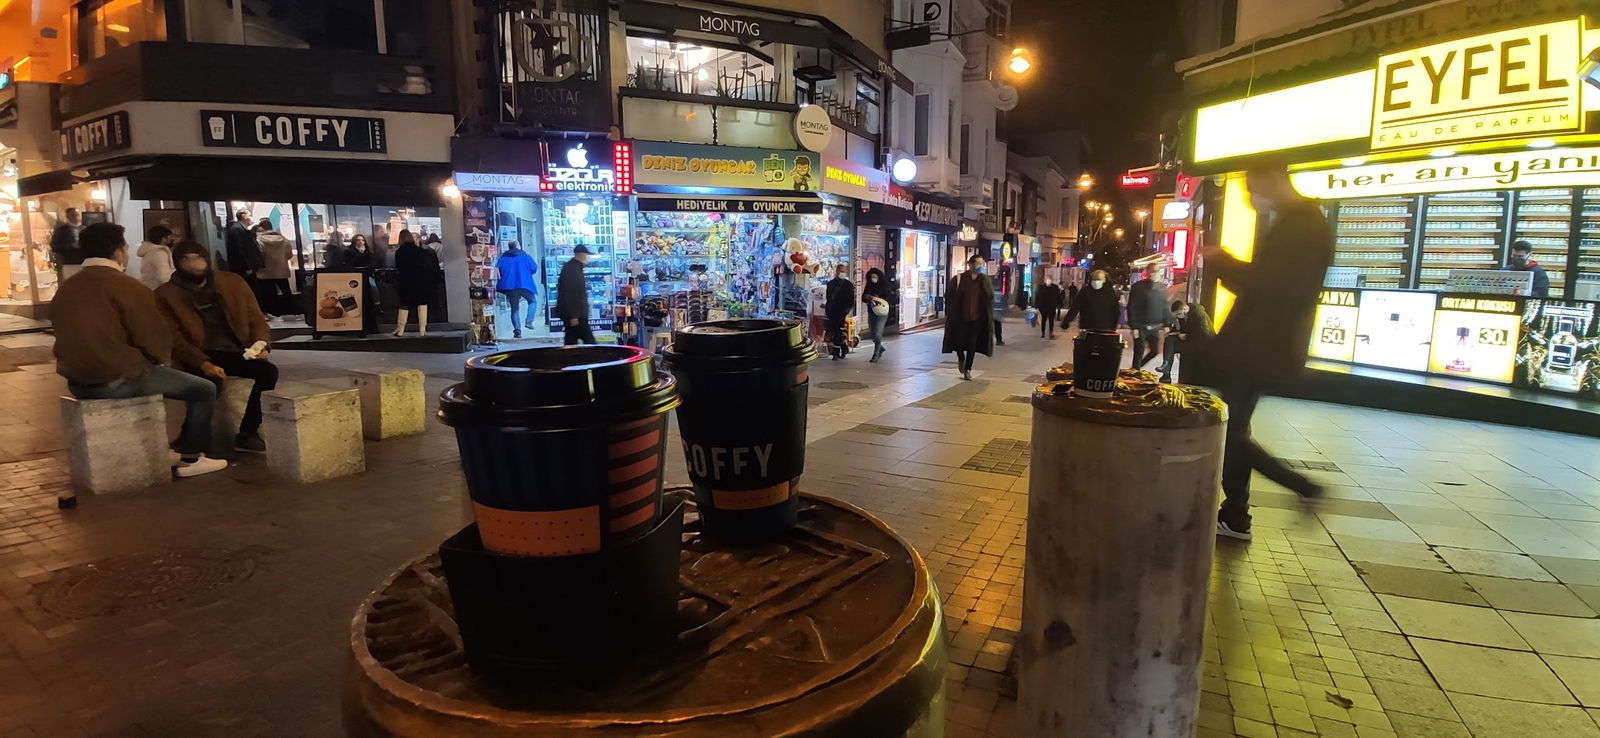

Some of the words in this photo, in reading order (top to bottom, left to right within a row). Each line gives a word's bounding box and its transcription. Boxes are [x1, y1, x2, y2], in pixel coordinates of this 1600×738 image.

[700, 15, 760, 37] MONTAG
[1383, 35, 1569, 112] EYFEL
[255, 115, 349, 148] COFFY
[800, 120, 829, 131] MONTAG
[1379, 131, 1418, 142] EAU
[1435, 125, 1458, 135] DE
[1475, 114, 1570, 129] PARFUM
[75, 118, 108, 154] COFFY
[764, 159, 786, 170] BEN
[472, 174, 524, 185] MONTAG
[764, 169, 786, 182] 10
[1328, 173, 1394, 189] her
[1416, 165, 1470, 180] an
[556, 181, 615, 191] elektronik
[738, 201, 745, 210] &
[753, 201, 796, 212] OYUNCAK
[1441, 297, 1475, 310] ORTAM
[1476, 299, 1516, 312] KOKUSU
